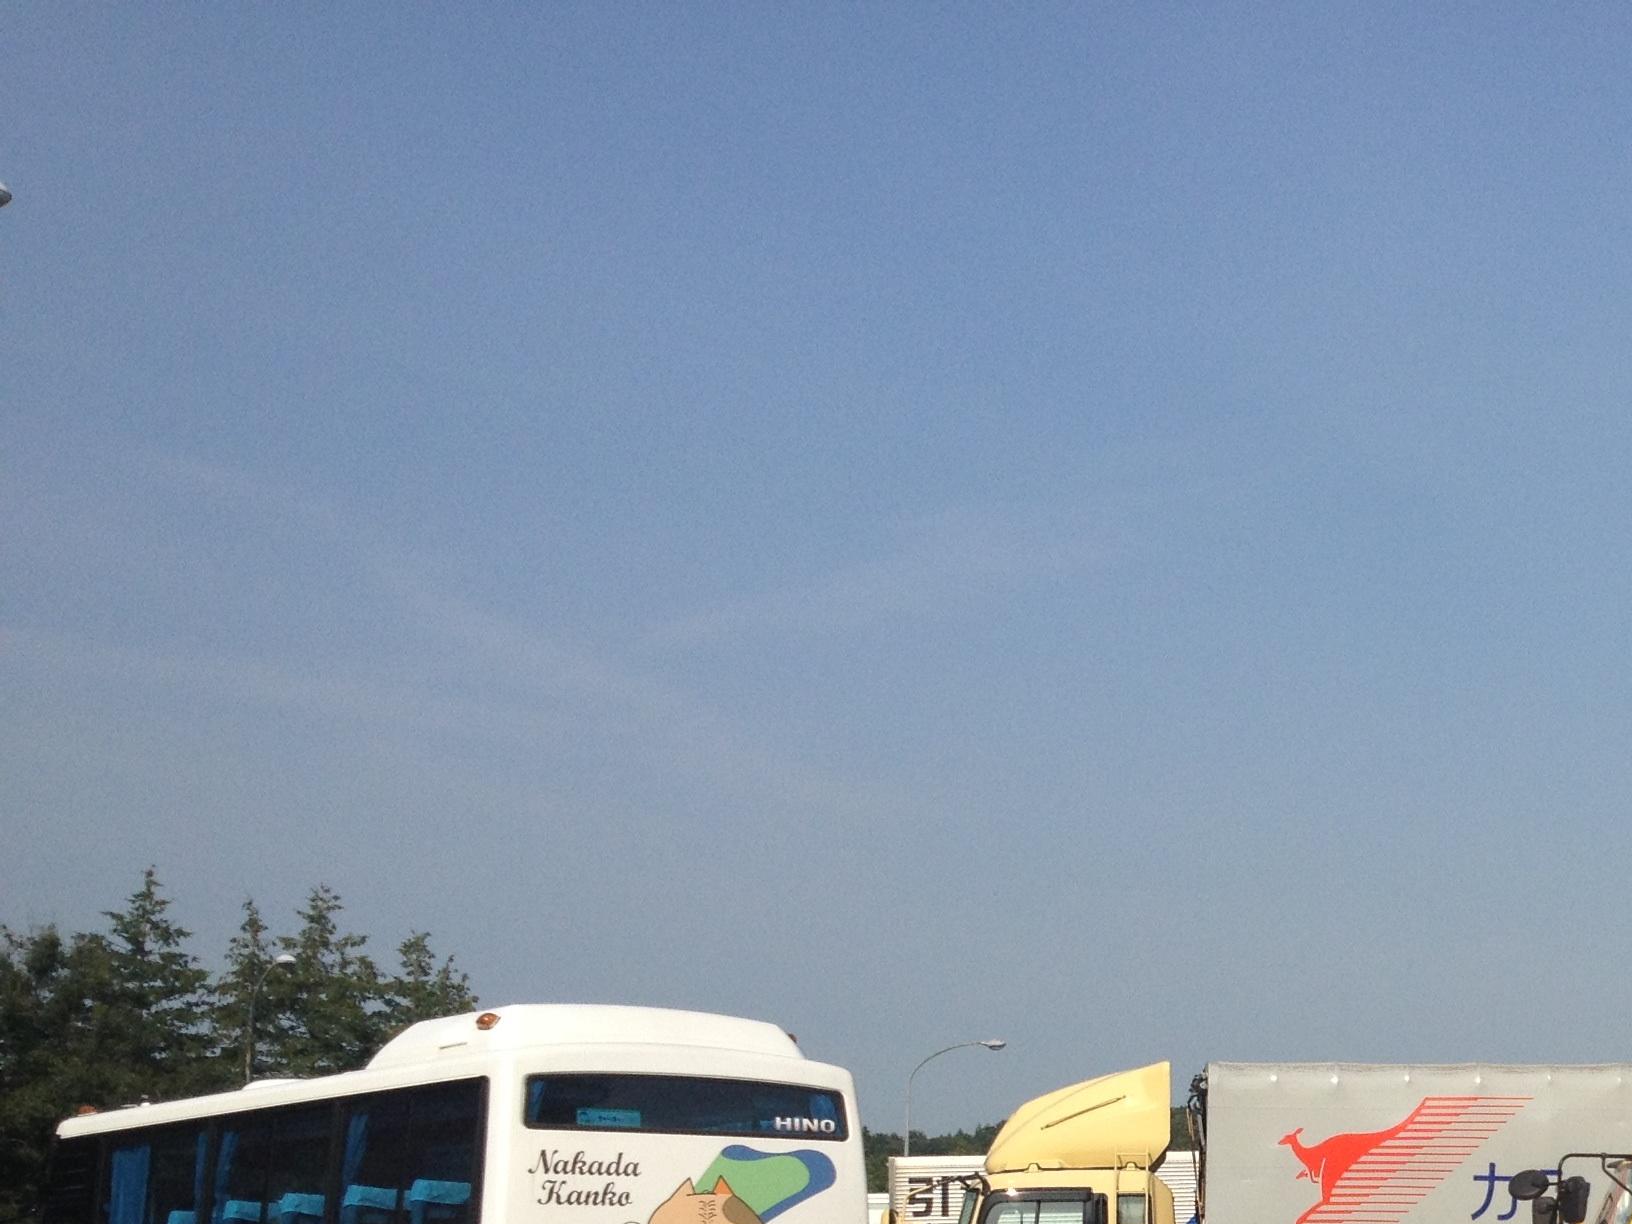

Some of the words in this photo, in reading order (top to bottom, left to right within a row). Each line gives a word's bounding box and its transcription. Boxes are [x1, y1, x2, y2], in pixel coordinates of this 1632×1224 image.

[774, 1116, 836, 1134] HINO
[527, 1149, 641, 1177] Nakada
[537, 1179, 633, 1207] Kanko
